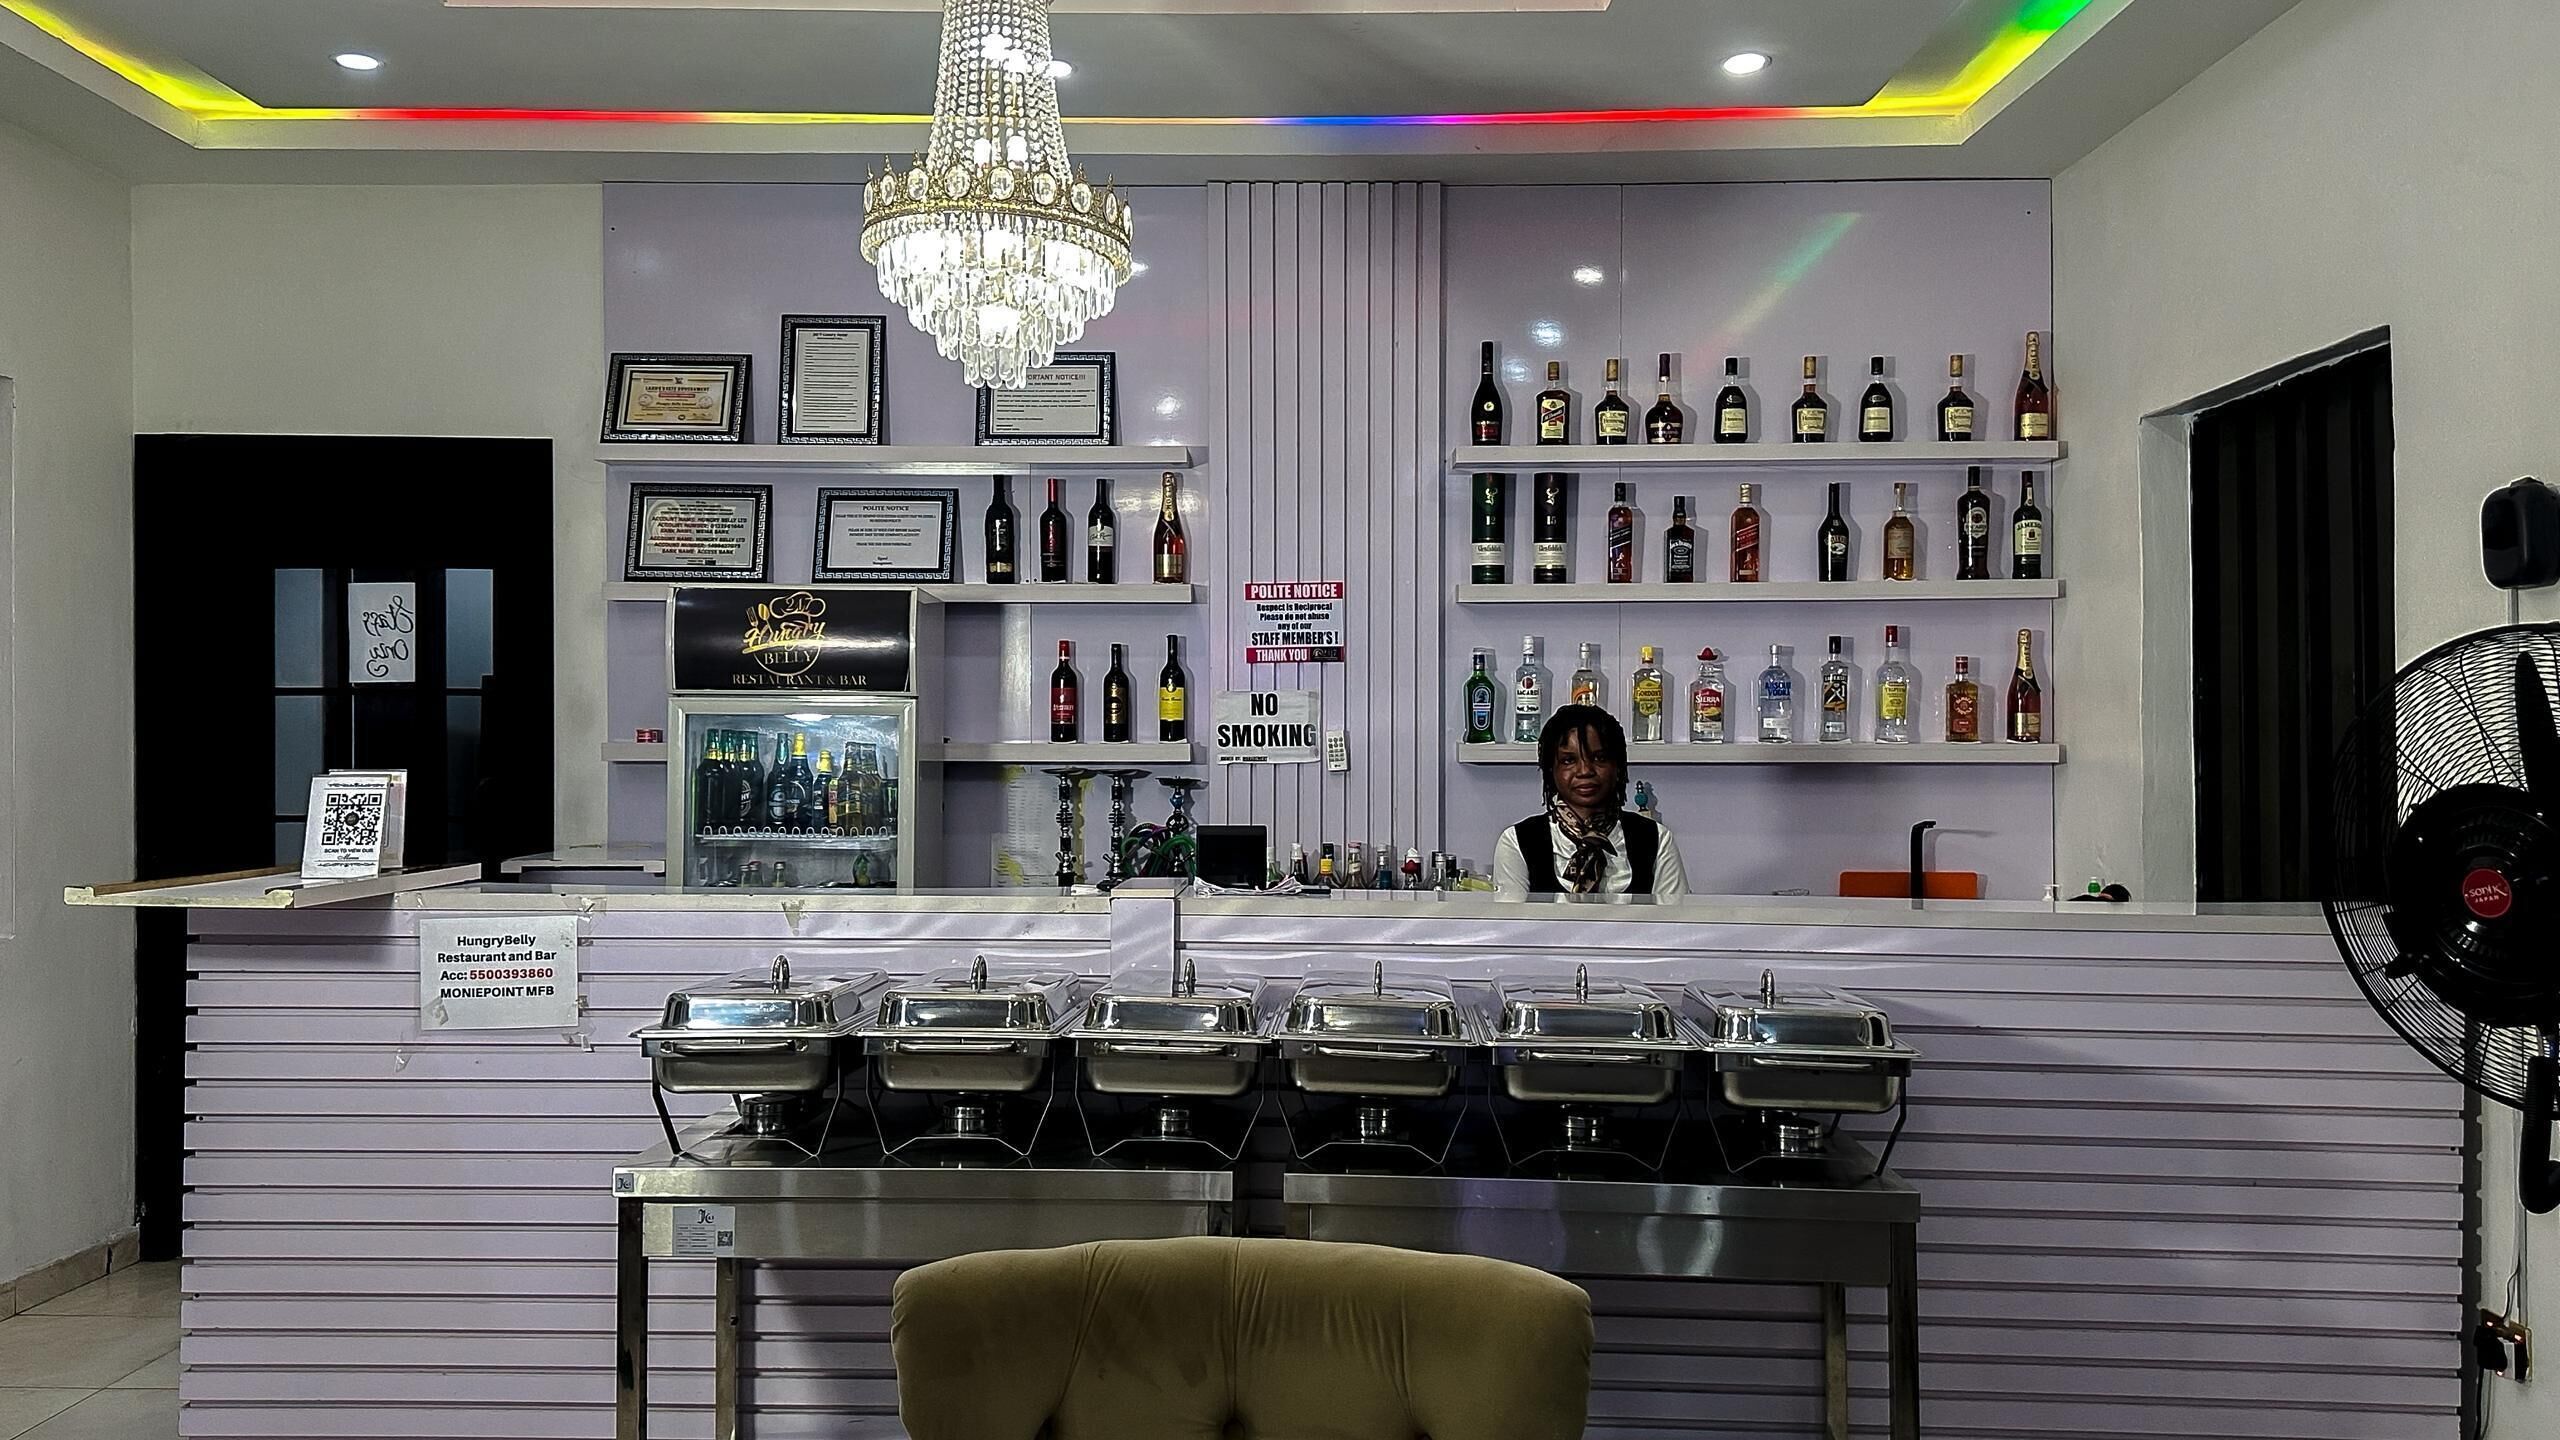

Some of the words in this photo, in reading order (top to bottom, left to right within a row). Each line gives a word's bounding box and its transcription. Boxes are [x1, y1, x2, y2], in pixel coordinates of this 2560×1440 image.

[1485, 515, 1496, 526] 12
[1546, 515, 1557, 526] 15
[1250, 584, 1292, 599] POLITE
[1293, 583, 1338, 598] NOTICE
[1256, 603, 1285, 612] Respect
[1294, 602, 1333, 611] Reciprocal
[1259, 613, 1284, 621] Please
[1307, 612, 1330, 620] abuse
[1277, 623, 1290, 631] any
[1291, 622, 1299, 630] of
[1299, 622, 1312, 630] our
[742, 621, 826, 652] Hungry
[1251, 632, 1280, 646] STAFF
[1281, 631, 1333, 645] MEMBER'S
[764, 650, 812, 665] BELLY
[1255, 649, 1287, 662] THANK
[1288, 648, 1308, 661] YOU
[732, 674, 822, 685] RESTAURANT
[839, 675, 867, 686] BAR
[1250, 692, 1278, 716] NO
[1695, 694, 1720, 703] SIERRA
[1217, 723, 1317, 748] SMOKING
[2474, 895, 2500, 903] JAPAN
[456, 934, 537, 949] HungryBelly
[437, 952, 507, 963] Restaurant
[508, 950, 534, 962] and
[535, 950, 558, 961] Bar
[440, 970, 468, 981] Acc:
[469, 968, 554, 980] 5500393860
[439, 986, 524, 999] MONIEPOINT
[525, 985, 555, 996] MFB
